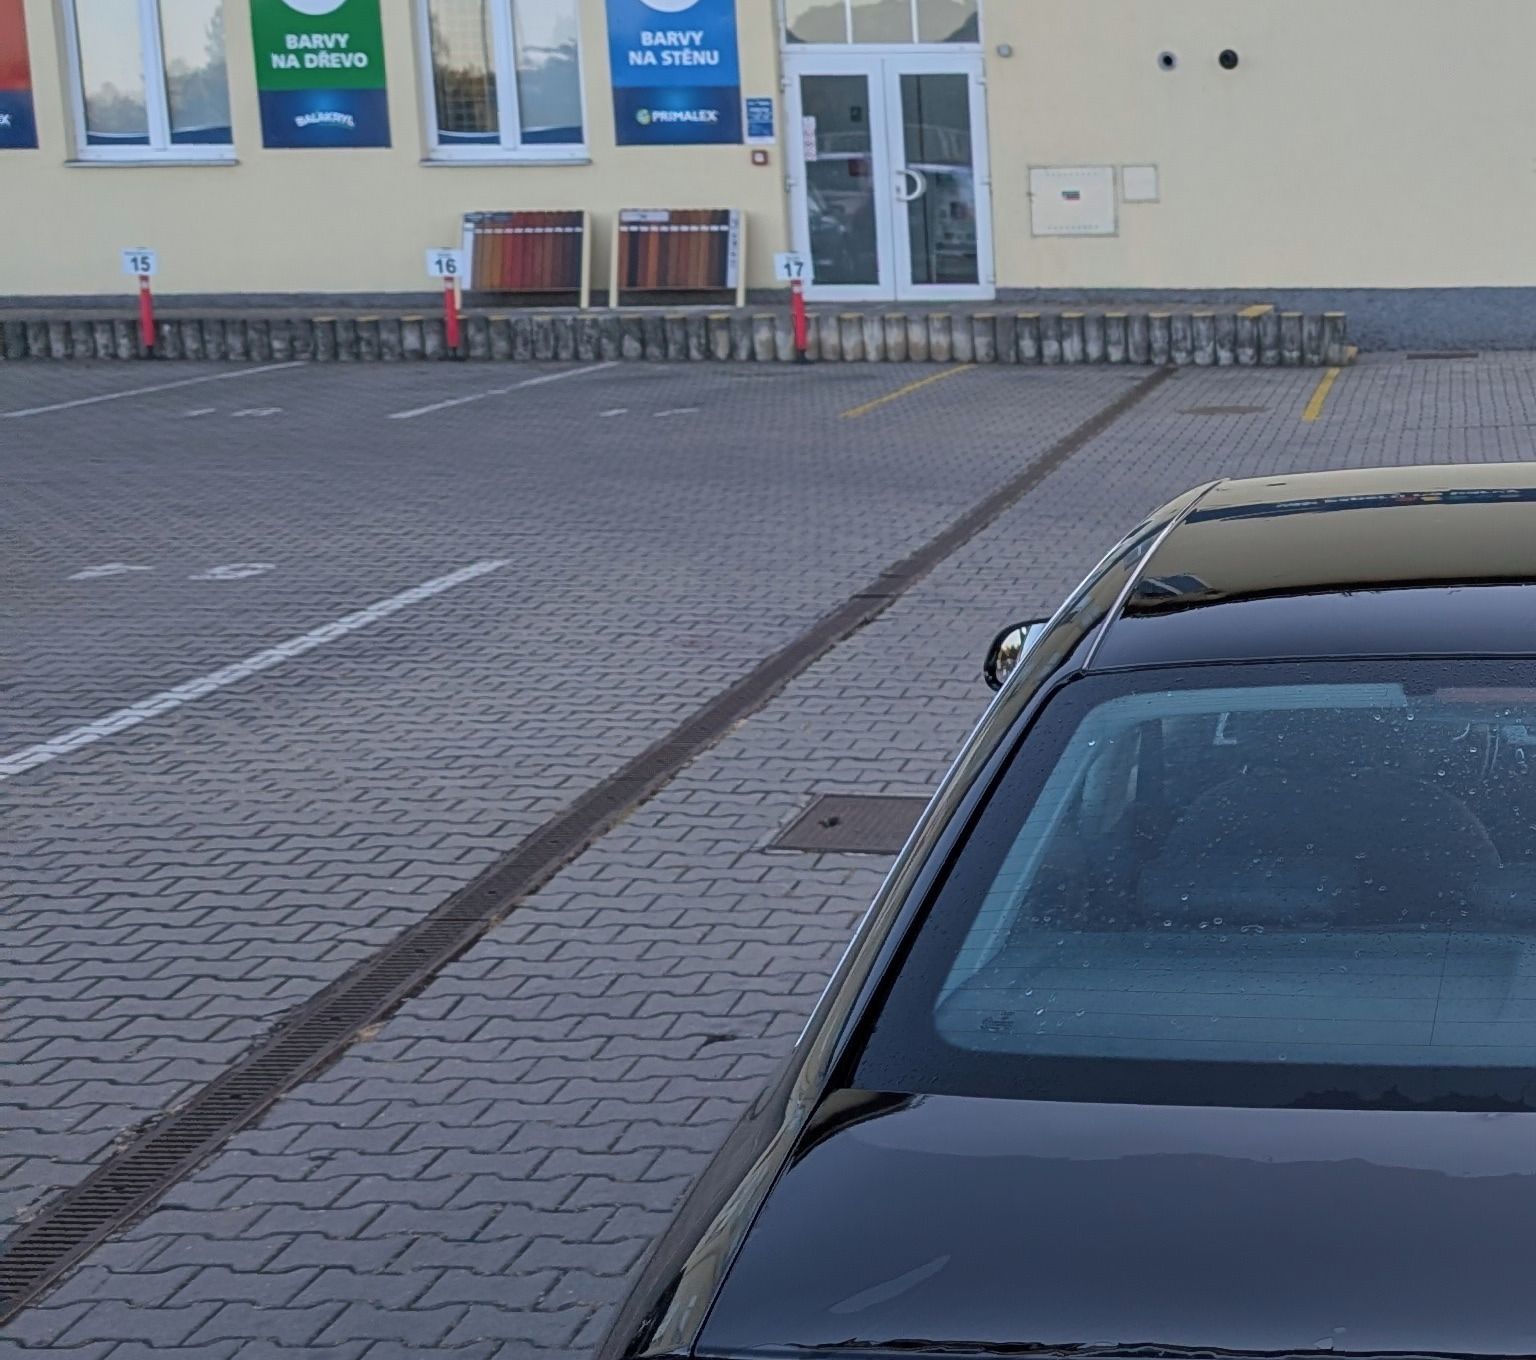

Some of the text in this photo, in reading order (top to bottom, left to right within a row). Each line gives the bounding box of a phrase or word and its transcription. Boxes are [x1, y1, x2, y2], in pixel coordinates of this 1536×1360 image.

[285, 33, 350, 50] BARVY
[640, 30, 704, 47] BARVY
[271, 49, 369, 69] NA DŘEVO
[628, 47, 720, 66] NA STĚNU
[652, 109, 719, 123] PRIMALEX
[130, 255, 151, 272] 15
[434, 258, 457, 274] 16
[783, 261, 804, 277] 17
